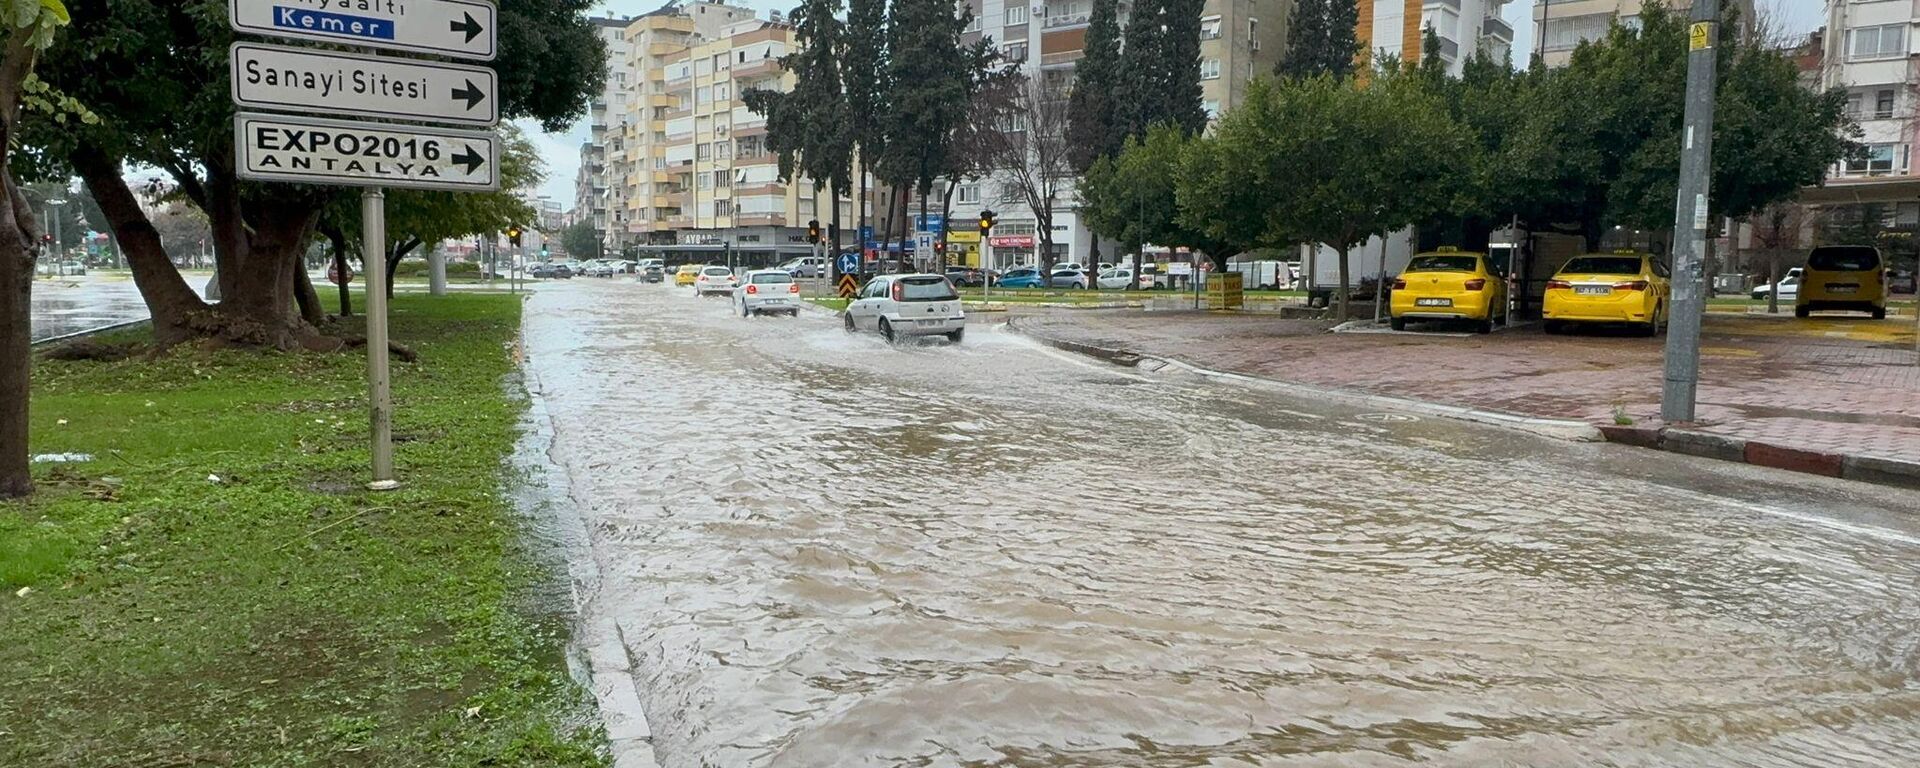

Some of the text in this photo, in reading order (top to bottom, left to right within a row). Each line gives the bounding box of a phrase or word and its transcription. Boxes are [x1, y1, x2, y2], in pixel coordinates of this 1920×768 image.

[281, 11, 379, 35] Kemer
[246, 59, 427, 99] Sanayi Sitesi
[256, 127, 440, 161] EXPO2016
[259, 154, 440, 177] ANTALYA
